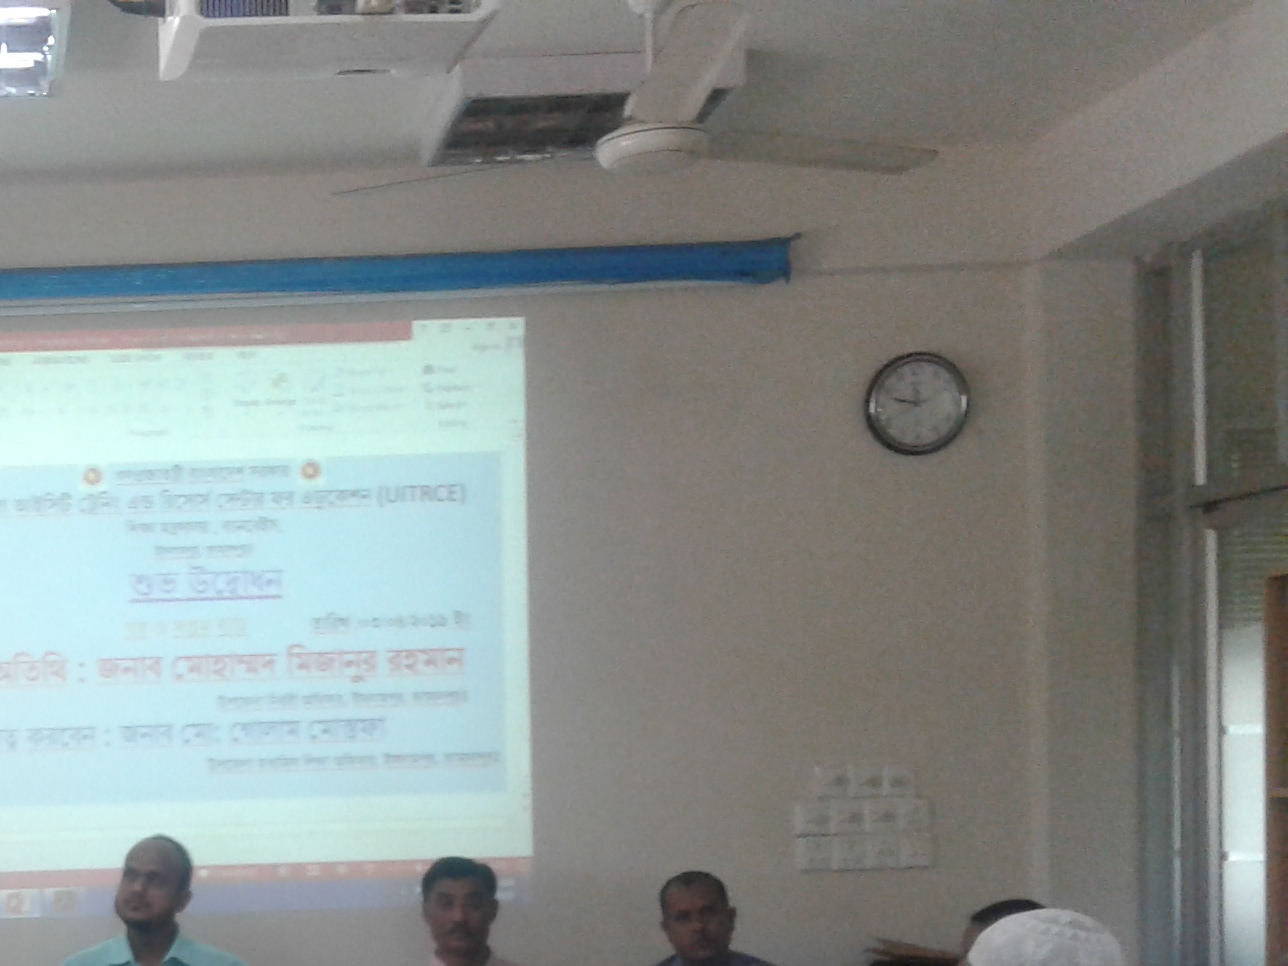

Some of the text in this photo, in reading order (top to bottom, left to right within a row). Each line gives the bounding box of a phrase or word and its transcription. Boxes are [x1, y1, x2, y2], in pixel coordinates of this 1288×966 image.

[376, 482, 467, 508] (UITRCE)
[96, 655, 165, 682] জনাব
[171, 651, 279, 682] মোহাম্মদ
[286, 643, 377, 684] মিজানুর
[386, 647, 465, 676] রহমান
